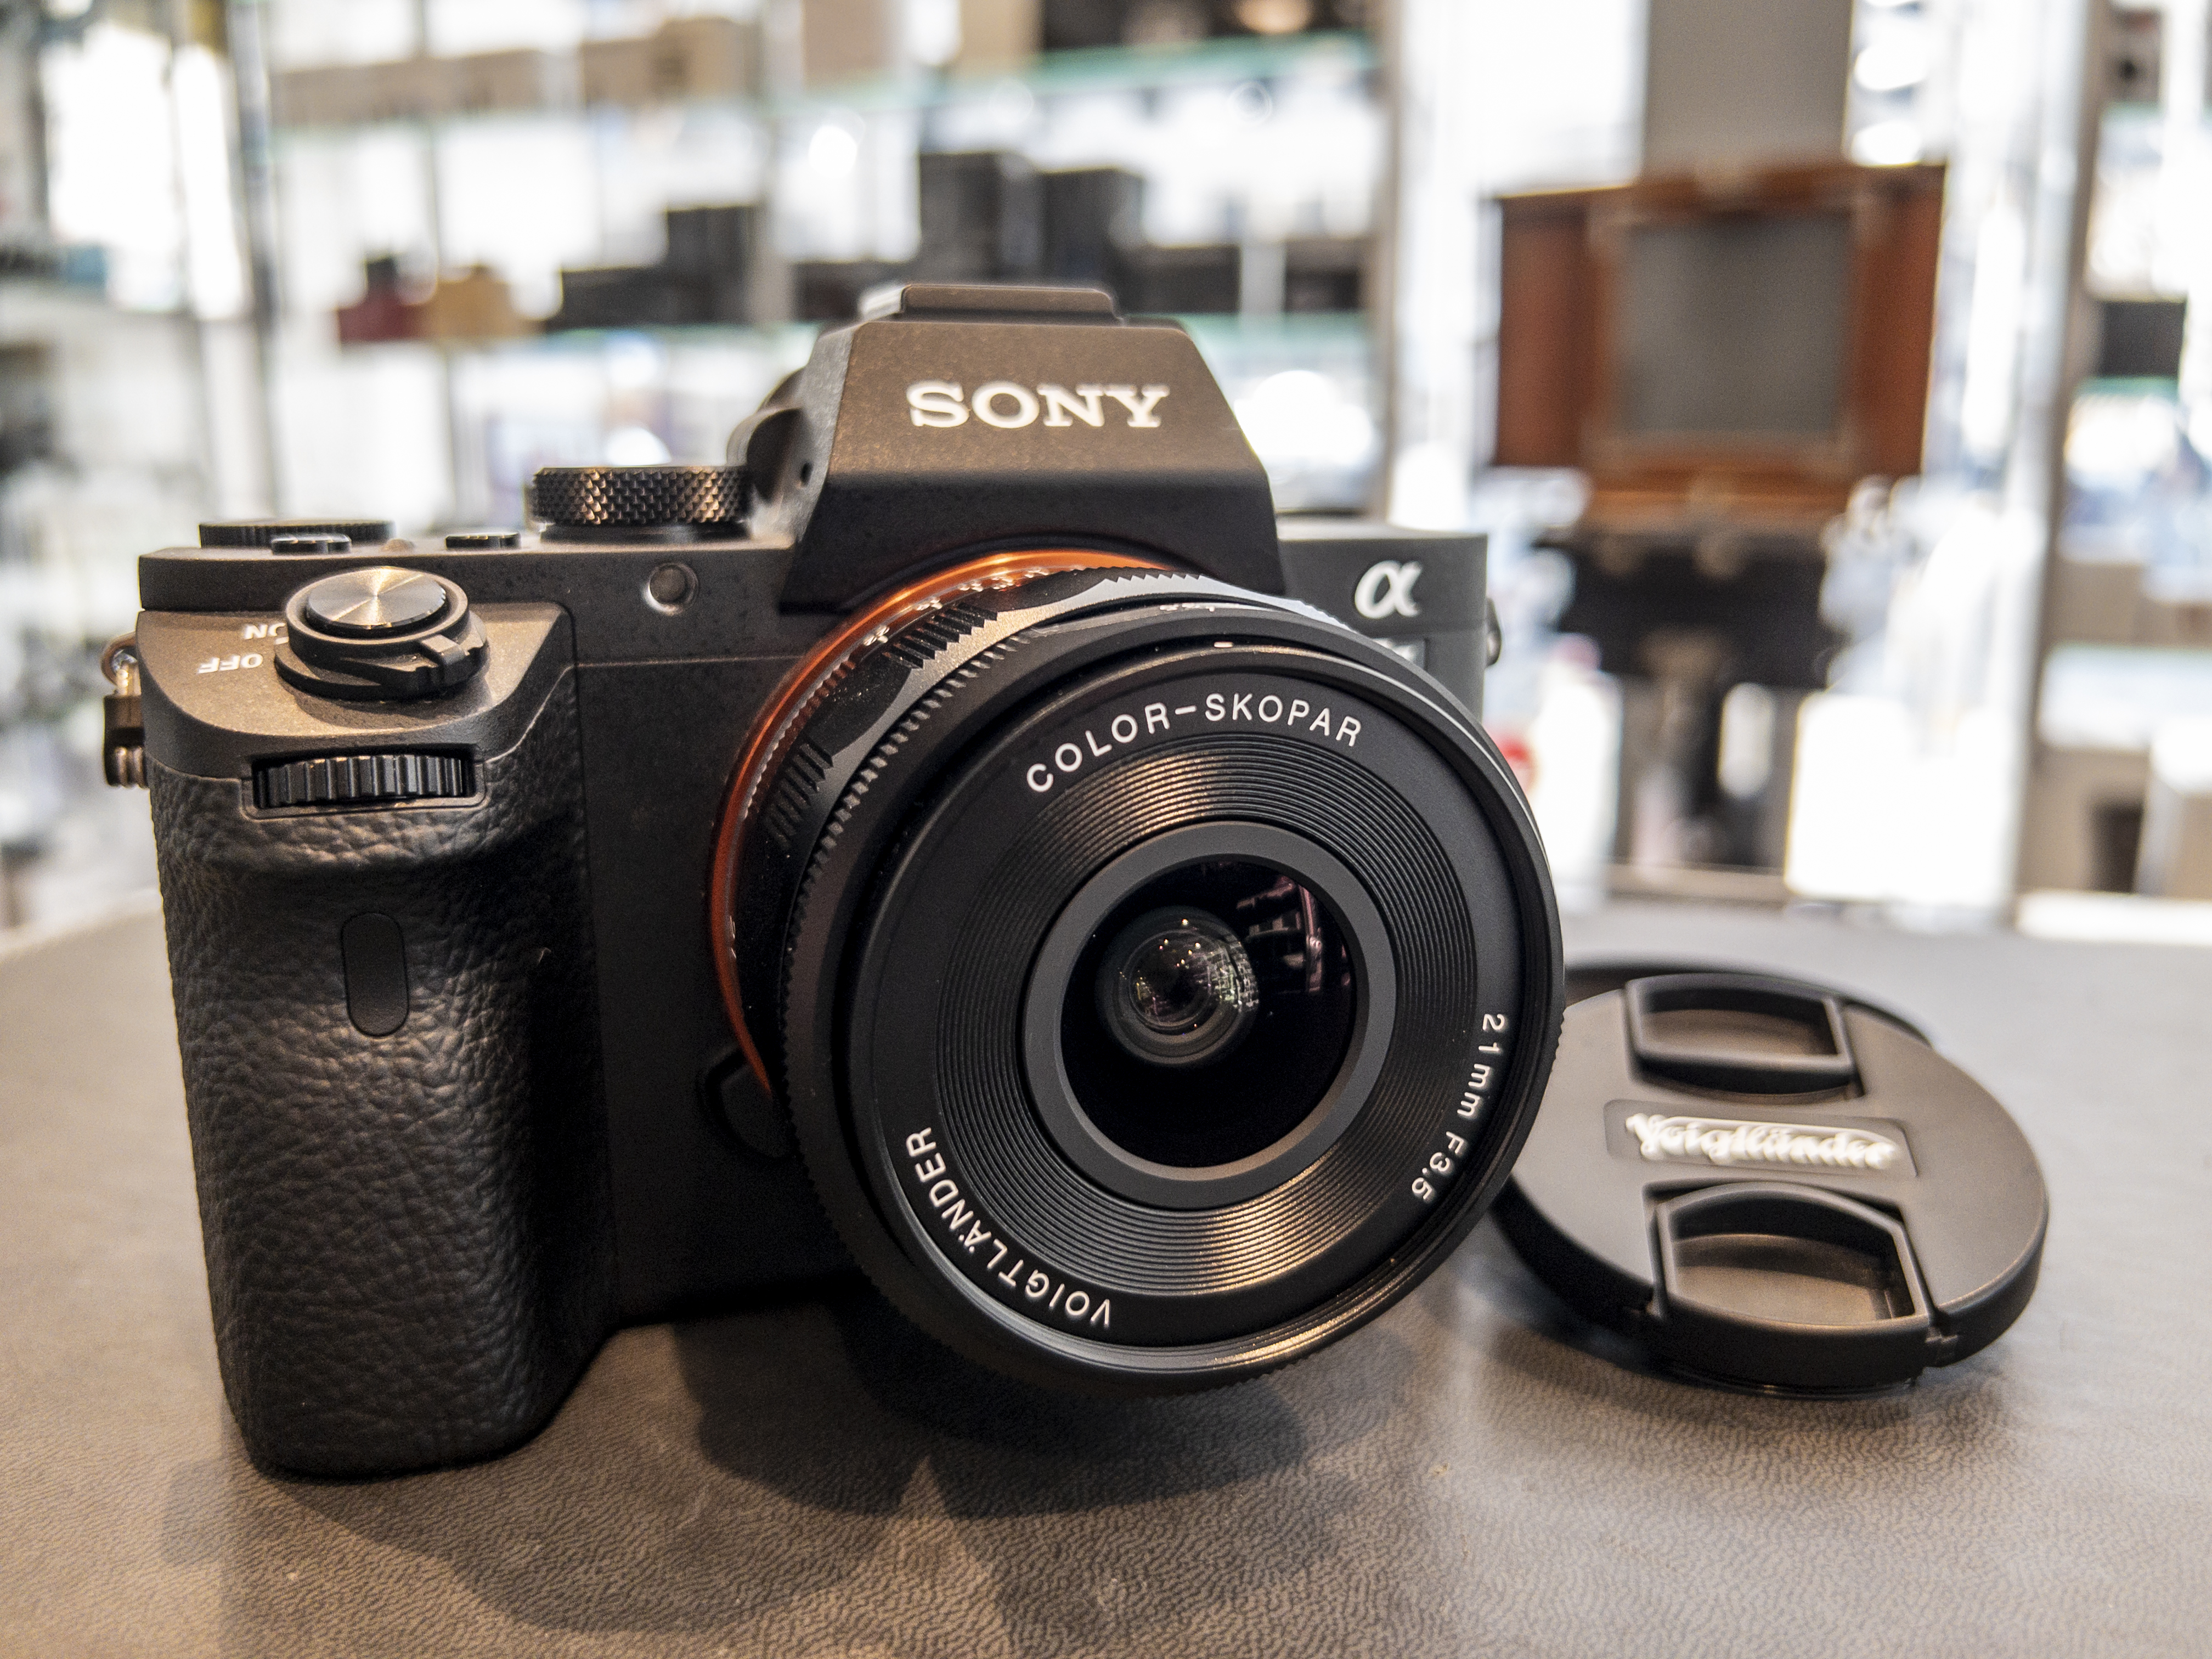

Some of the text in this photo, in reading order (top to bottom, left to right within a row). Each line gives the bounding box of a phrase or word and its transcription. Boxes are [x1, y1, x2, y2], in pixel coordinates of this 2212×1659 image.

[906, 380, 1170, 428] SONY
[198, 653, 264, 674] OFF
[1026, 693, 1362, 792] COLOR-SKOPAR
[1411, 1013, 1506, 1201] 21mm F3.5
[906, 1126, 1112, 1327] VOIGTLÄNDER
